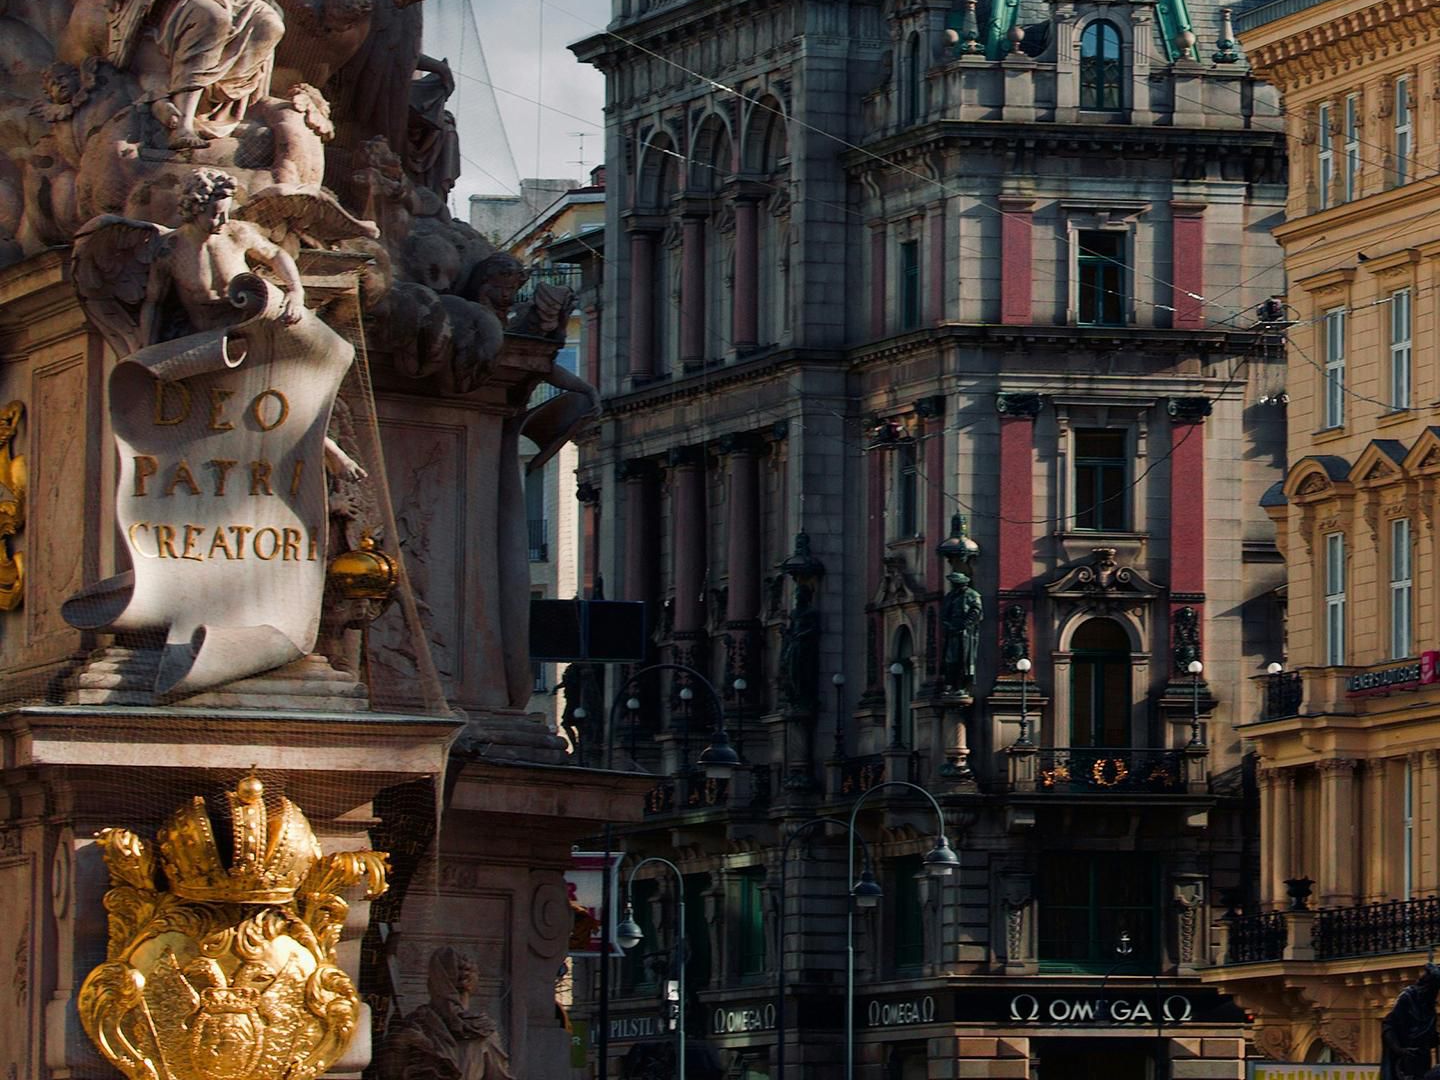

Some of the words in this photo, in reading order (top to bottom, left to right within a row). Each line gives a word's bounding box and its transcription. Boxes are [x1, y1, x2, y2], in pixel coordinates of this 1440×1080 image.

[153, 379, 289, 431] DEO
[132, 456, 304, 497] PATRI
[129, 523, 319, 561] CREATORI
[726, 1010, 762, 1033] OMEGA
[881, 1001, 921, 1025] OMEGA
[1049, 999, 1153, 1021] OMGA
